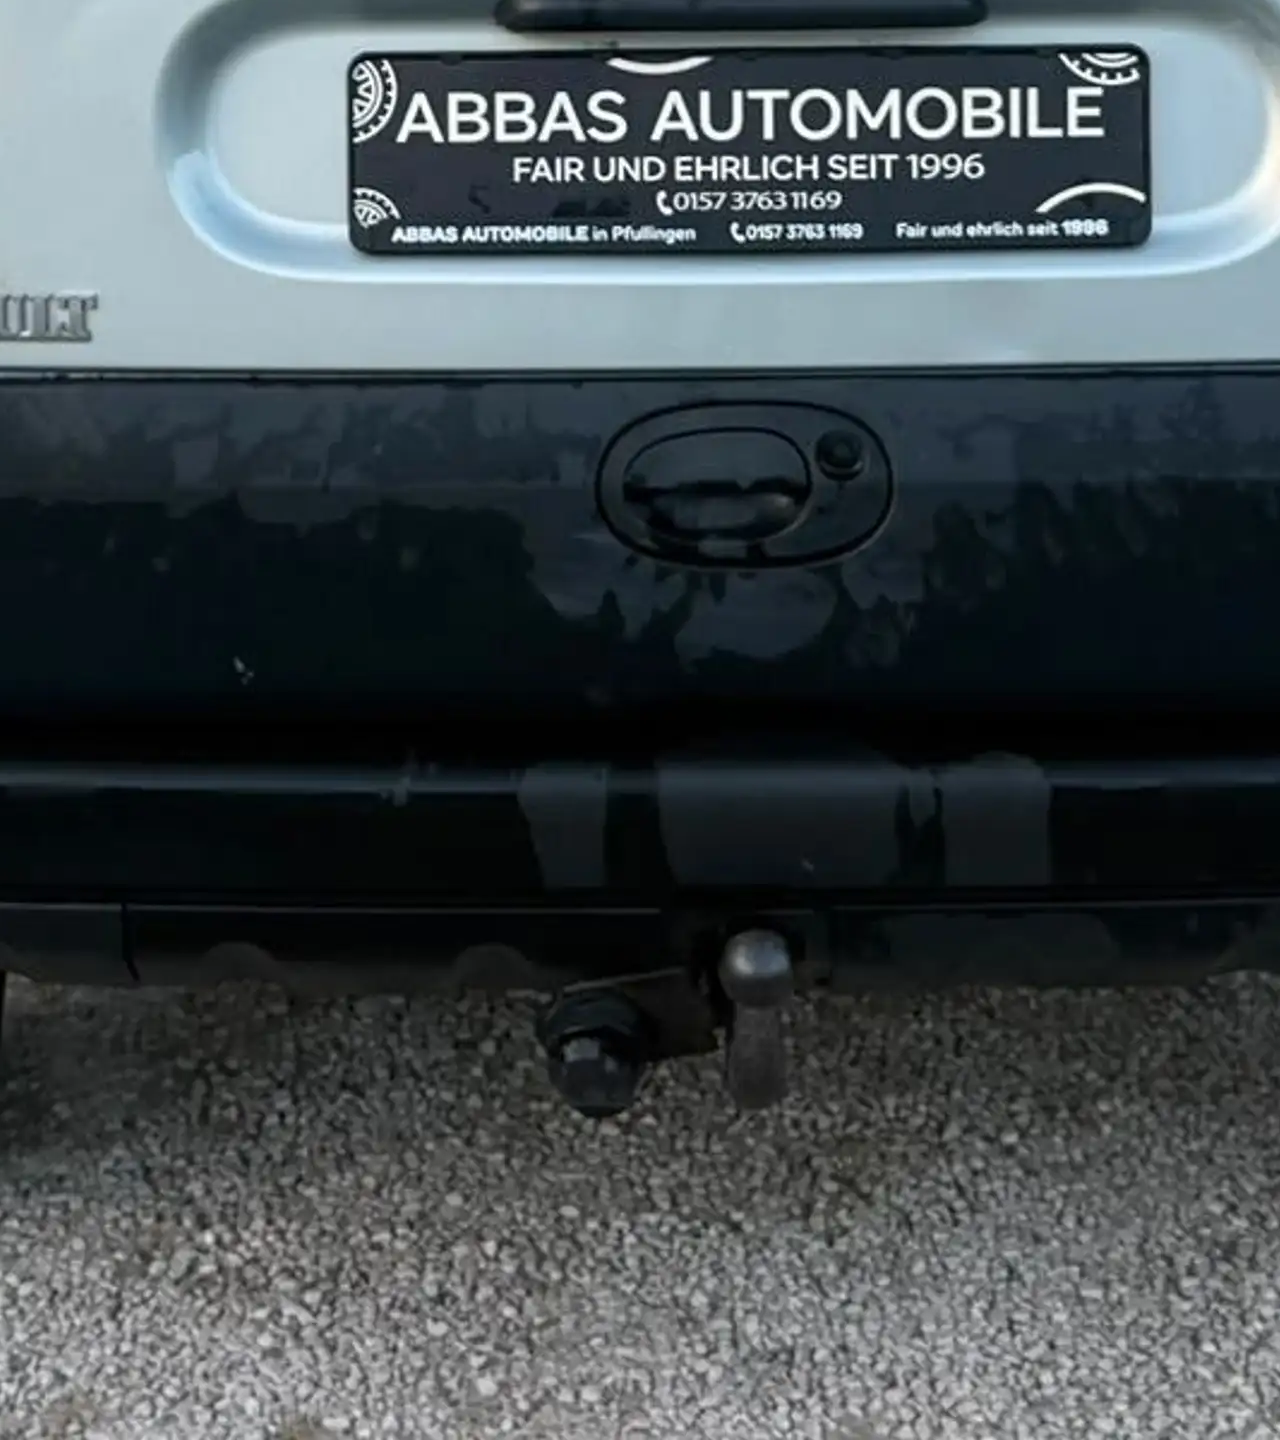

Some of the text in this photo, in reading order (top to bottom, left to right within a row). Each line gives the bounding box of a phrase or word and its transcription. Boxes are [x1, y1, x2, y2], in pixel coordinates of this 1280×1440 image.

[395, 86, 1106, 144] ABBAS AUTOMOBILE
[513, 153, 986, 182] FAIR UND EHRLICH SEIT 1996
[673, 190, 843, 211] 0157 3763 1169
[391, 225, 696, 244] ABBAS AUTOMOBILE in Pfullingen
[895, 222, 928, 238] Fair
[931, 222, 963, 238] und
[966, 220, 1023, 238] ehrlich
[1026, 220, 1058, 236] seit
